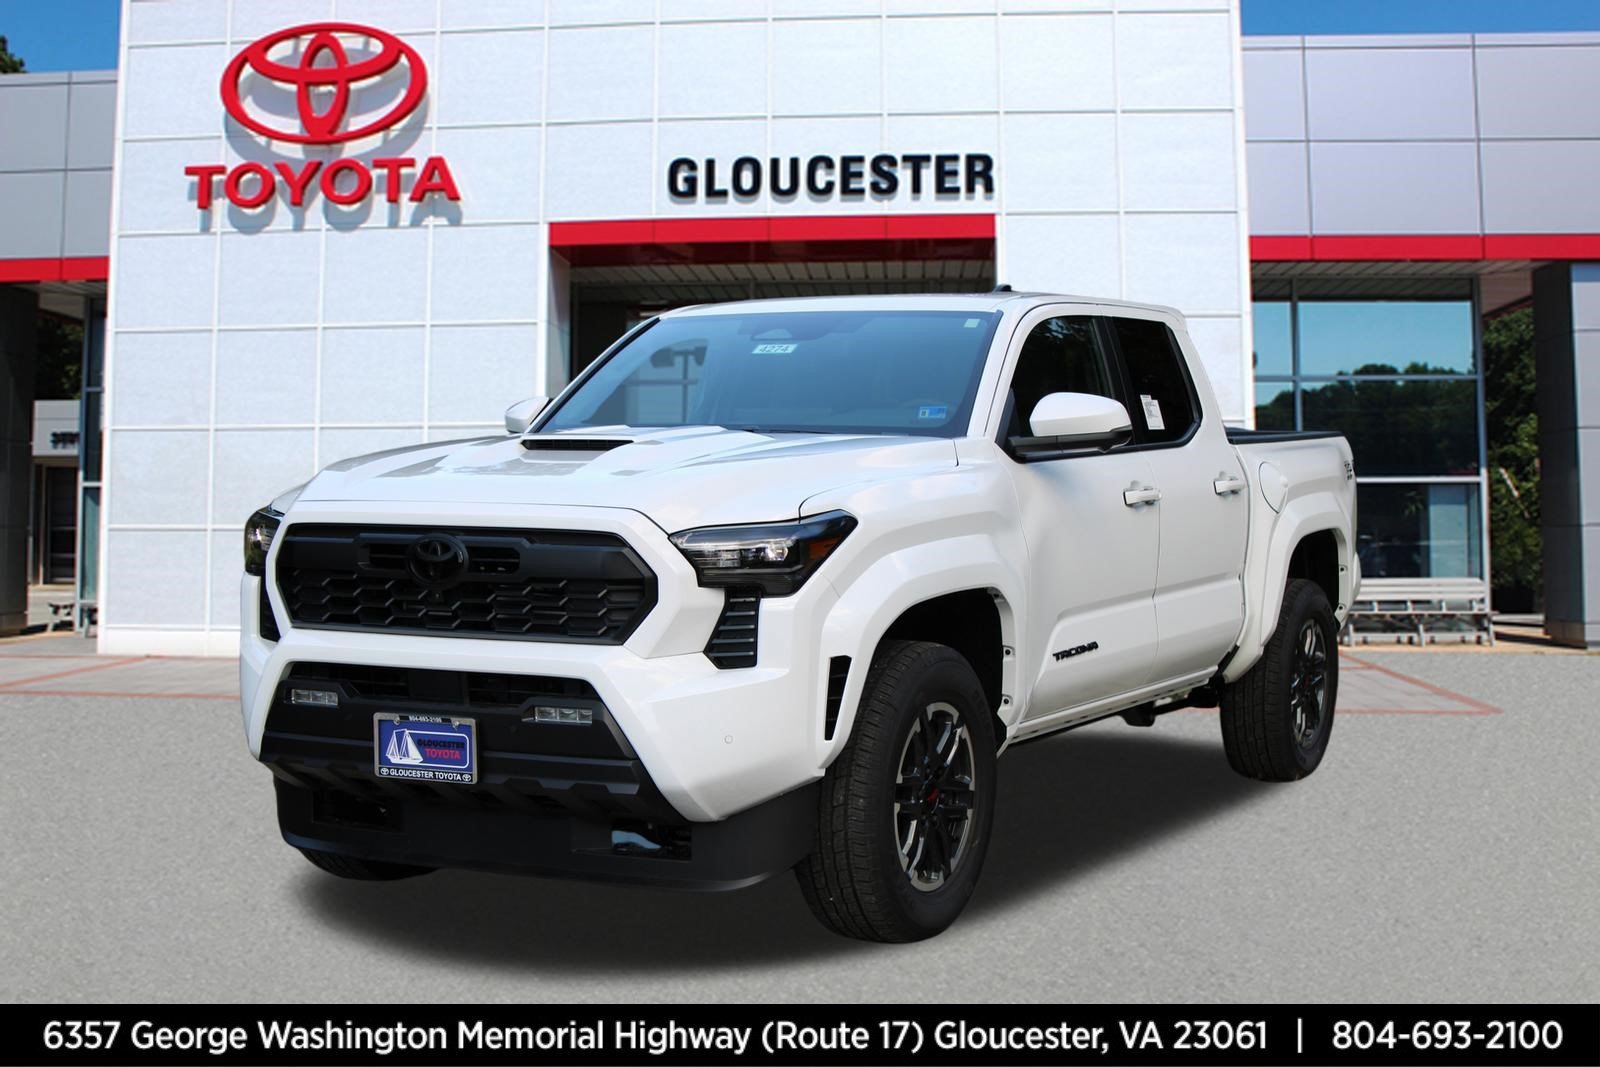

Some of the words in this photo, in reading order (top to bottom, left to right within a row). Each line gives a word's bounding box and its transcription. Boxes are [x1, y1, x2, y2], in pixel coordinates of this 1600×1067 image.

[185, 156, 461, 210] TOYOTA
[669, 154, 994, 200] GLOUCESTER
[1052, 641, 1099, 662] TACOMA
[417, 738, 465, 749] GLOUCESTER
[424, 748, 461, 760] TOYOTA
[389, 768, 434, 779] GLOUCESTER
[435, 771, 462, 781] TOYOTA
